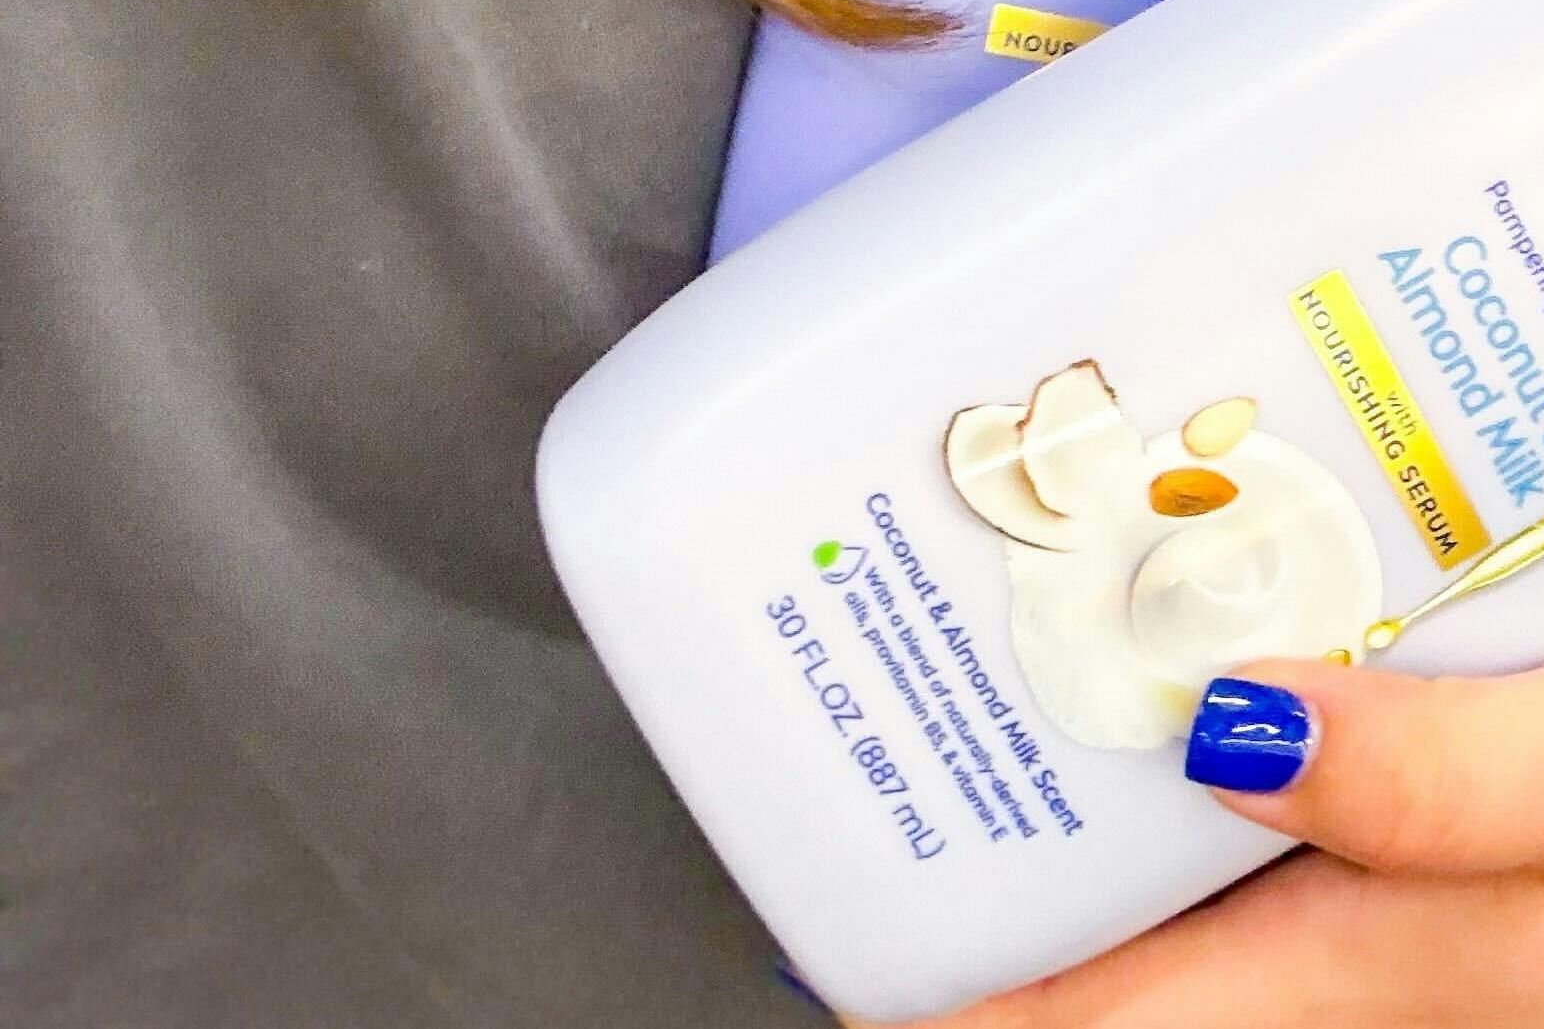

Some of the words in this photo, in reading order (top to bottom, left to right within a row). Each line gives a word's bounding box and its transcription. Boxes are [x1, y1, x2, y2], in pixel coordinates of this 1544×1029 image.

[1377, 246, 1501, 418] Almond
[1298, 289, 1405, 460] NOURISHING
[1397, 464, 1457, 556] SERUM
[1386, 390, 1419, 438] with
[866, 492, 939, 601] Coconut
[865, 566, 896, 613] With
[890, 613, 904, 627] a
[899, 626, 938, 678] blend
[930, 680, 952, 698] of
[928, 601, 953, 625] &
[766, 595, 807, 638] 30
[850, 736, 911, 797] (887
[892, 803, 948, 859] mL)
[940, 626, 1013, 719] Almond
[863, 628, 929, 722] provitamin
[952, 765, 997, 828] vitamin
[991, 826, 1009, 843] E
[1000, 717, 1041, 772] Milk
[1031, 769, 1084, 836] Scent
